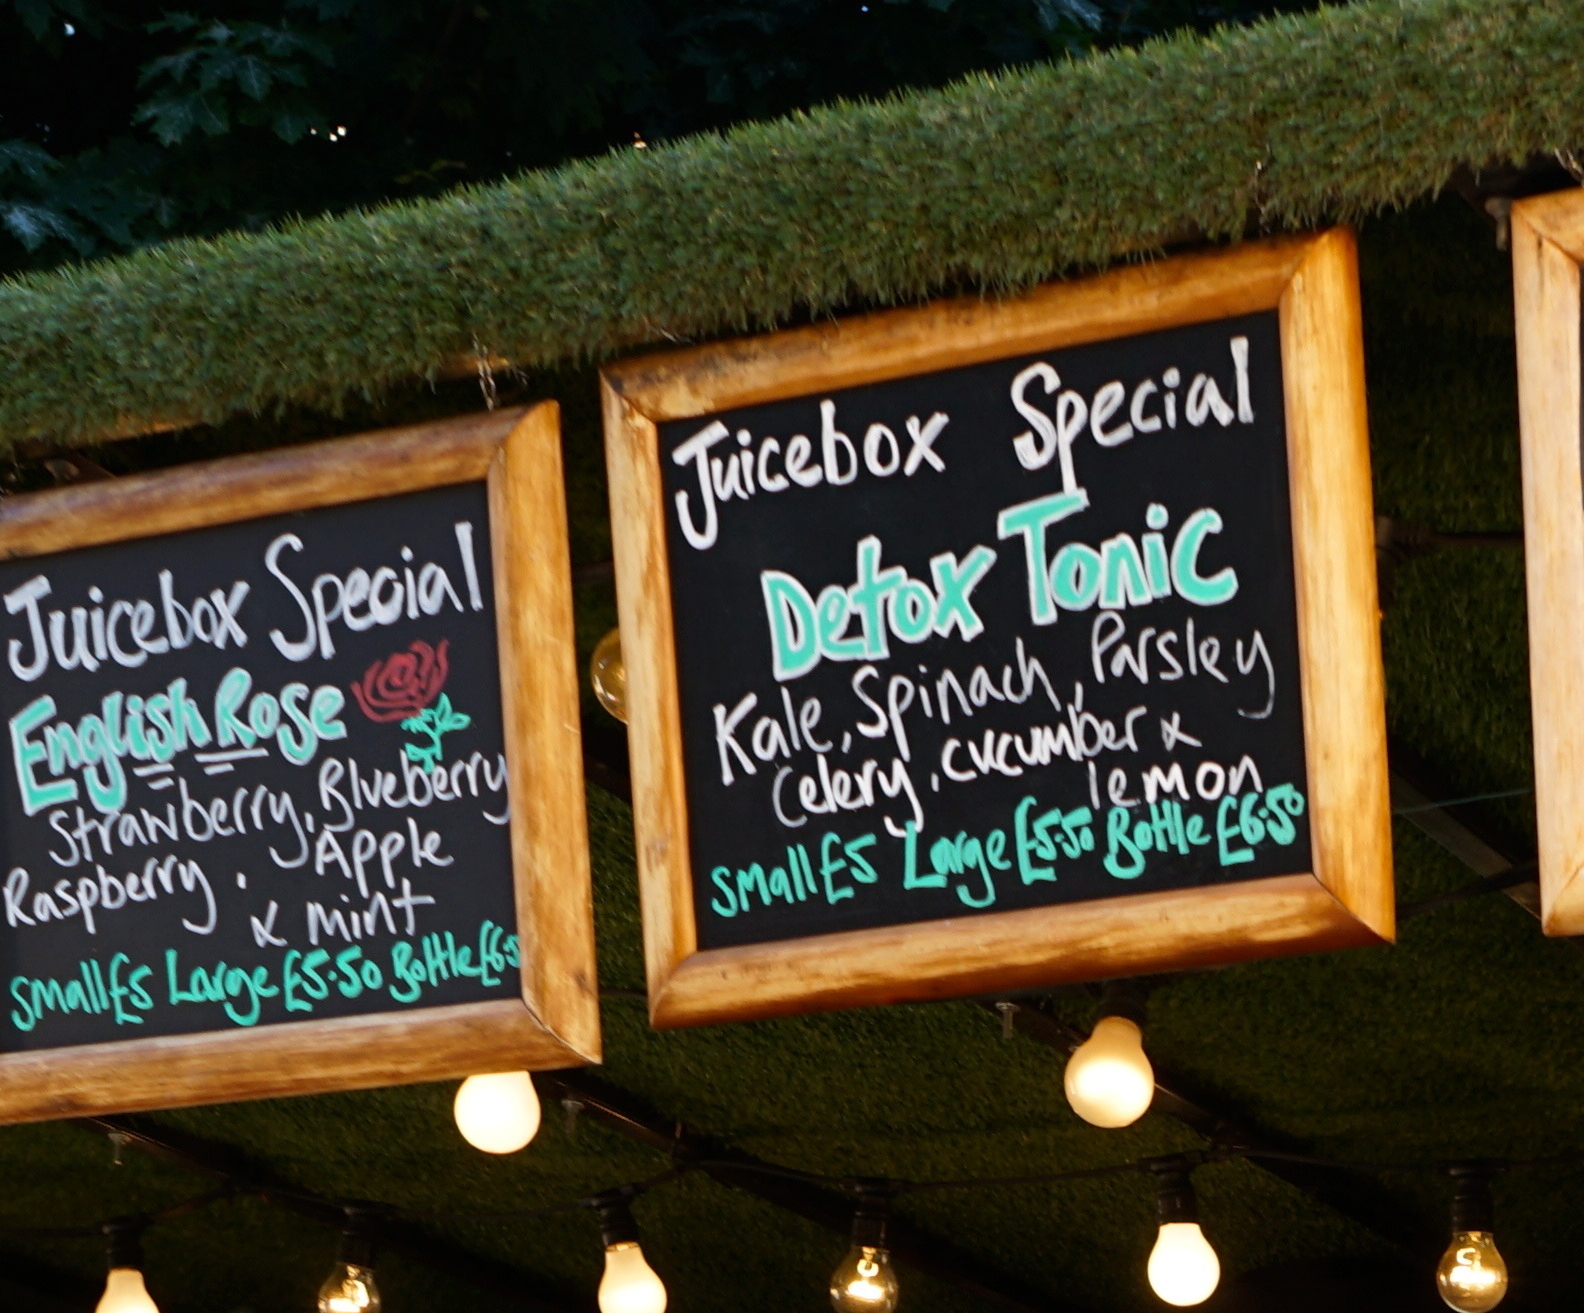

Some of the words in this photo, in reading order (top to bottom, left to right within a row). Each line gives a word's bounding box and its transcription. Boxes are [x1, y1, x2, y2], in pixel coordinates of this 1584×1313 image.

[673, 400, 949, 549] Juicebox
[1010, 336, 1255, 493] Special
[4, 570, 249, 682] Juicebox
[265, 521, 484, 663] Special
[762, 534, 997, 682] Detox
[999, 487, 1238, 624] Tonic
[1091, 611, 1275, 718] Parsley
[9, 676, 211, 816] English
[215, 669, 348, 765] Rose
[941, 703, 1148, 782] cucumber
[1089, 754, 1263, 810] lemon
[318, 819, 453, 882] Apple
[819, 831, 879, 906] £5
[904, 822, 1009, 908] Large
[1104, 800, 1211, 878] Bottle
[167, 948, 280, 1027] Large
[390, 931, 483, 1003] Bottle
